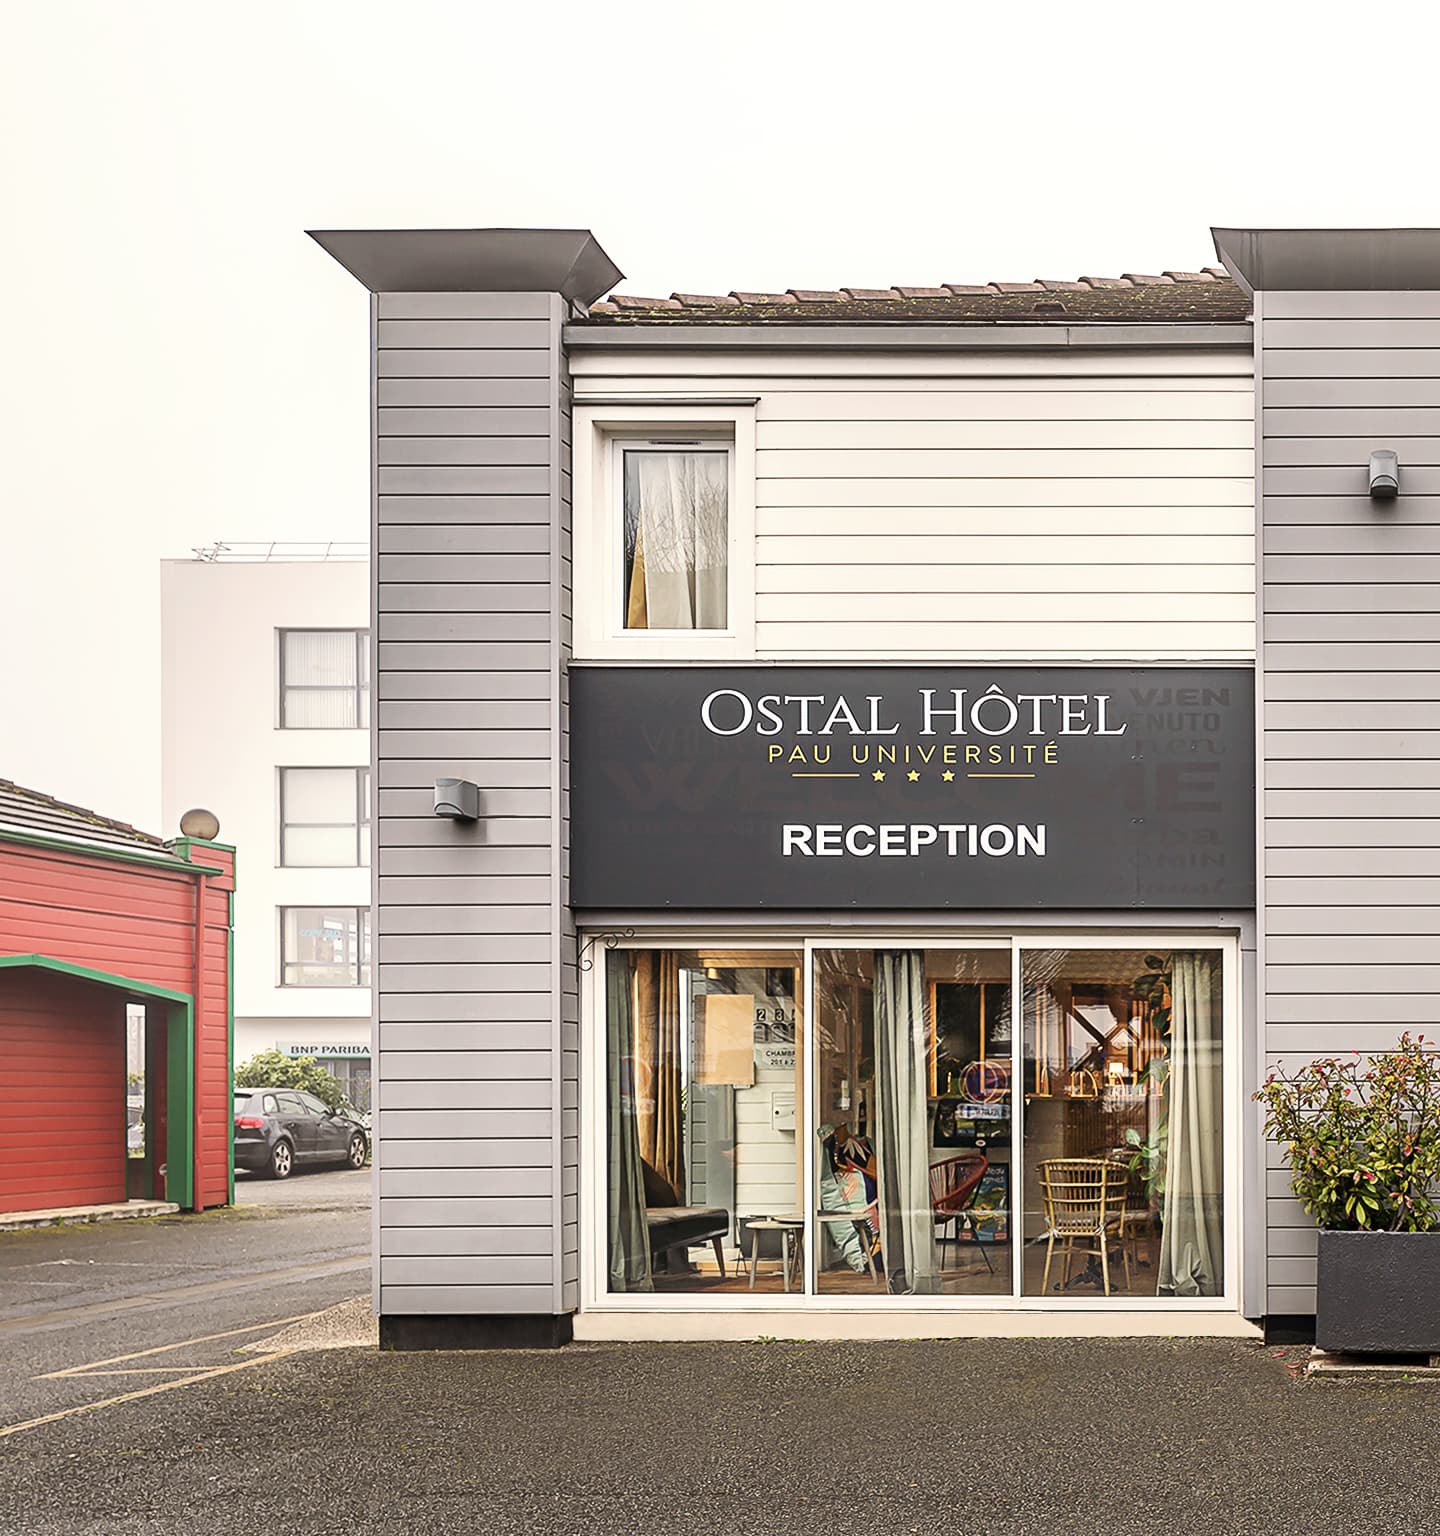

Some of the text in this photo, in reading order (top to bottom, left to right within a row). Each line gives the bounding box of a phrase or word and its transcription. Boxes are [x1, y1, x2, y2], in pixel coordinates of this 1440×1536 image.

[701, 684, 1128, 736] OSTAL HÔTEL
[769, 741, 1059, 764] PAU UNIVERSITÉ
[782, 824, 1046, 856] RECEPTION
[291, 1046, 318, 1054] BNP
